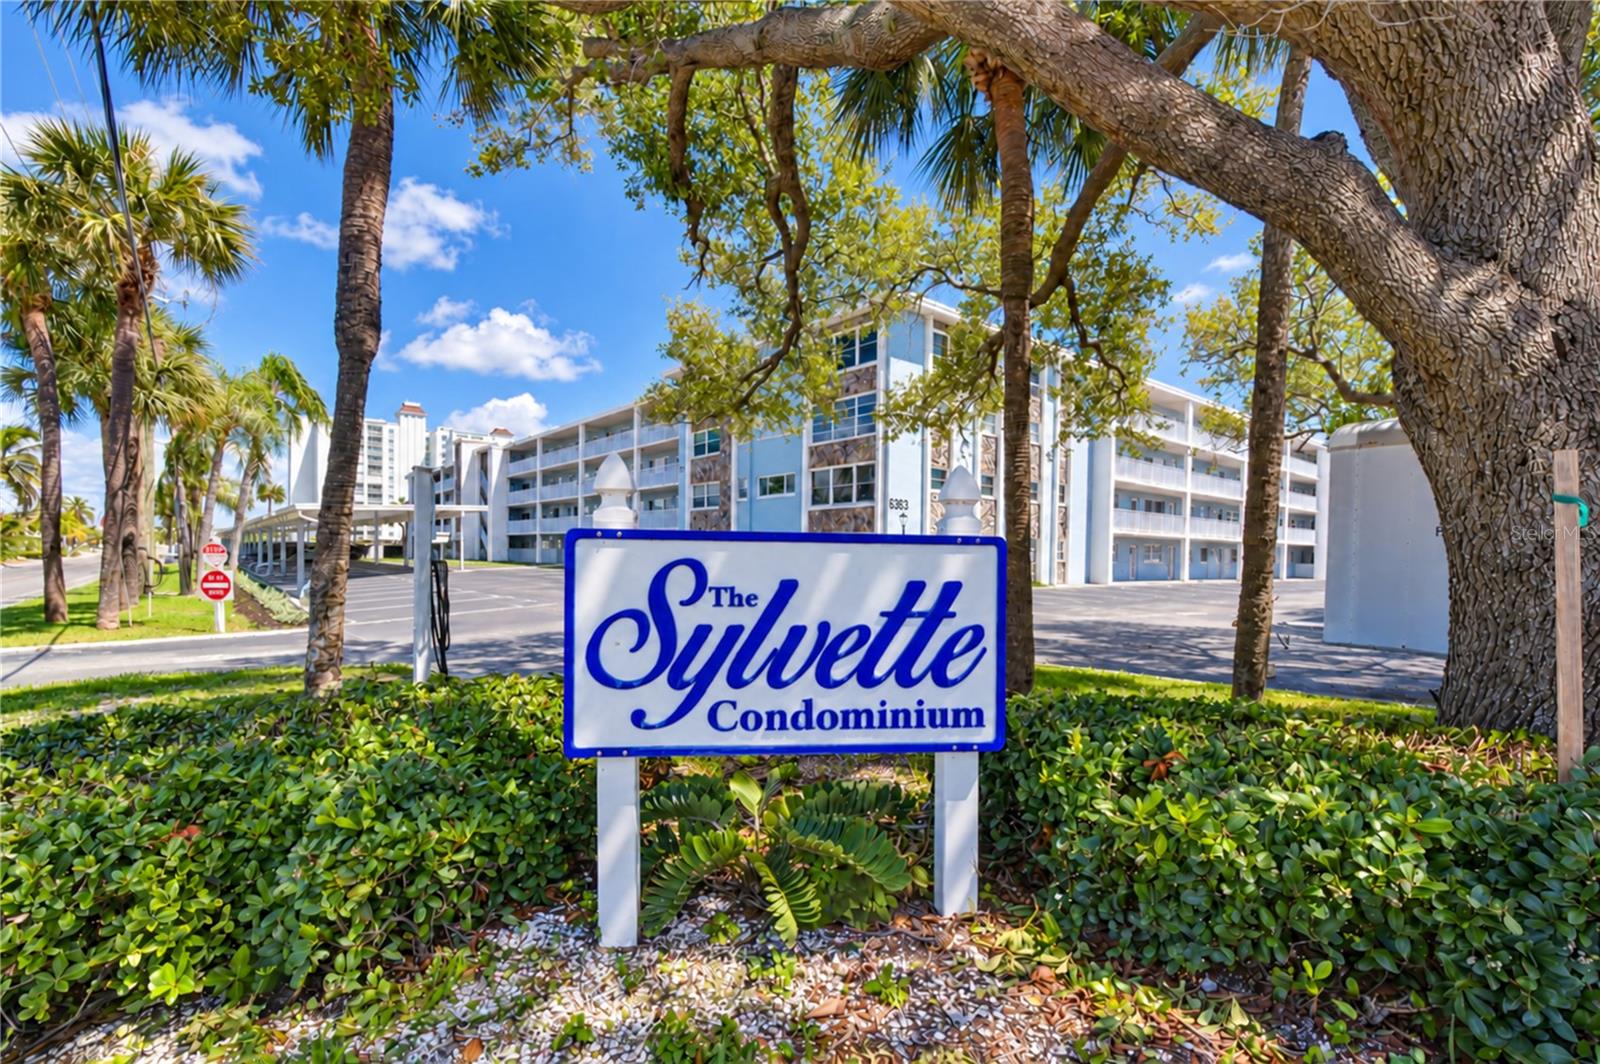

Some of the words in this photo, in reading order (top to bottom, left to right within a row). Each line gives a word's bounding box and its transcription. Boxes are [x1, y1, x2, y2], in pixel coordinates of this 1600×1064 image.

[889, 498, 909, 510] 6363
[709, 586, 759, 608] The
[585, 557, 988, 730] Sylvette
[707, 699, 986, 732] Condominium
